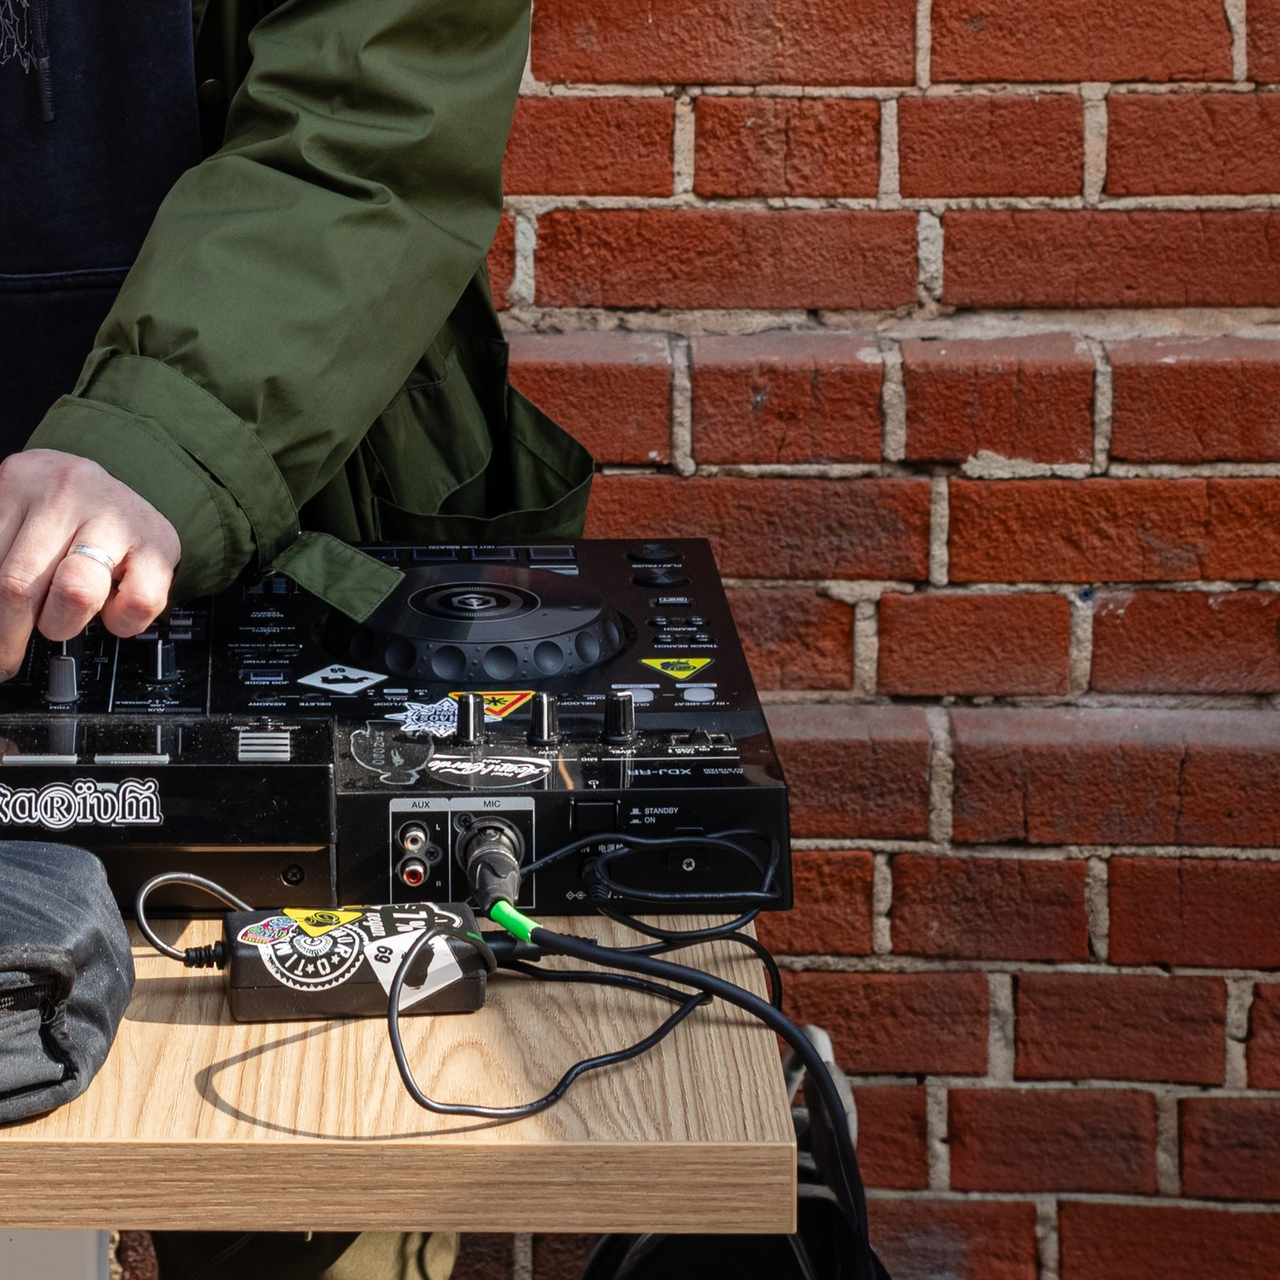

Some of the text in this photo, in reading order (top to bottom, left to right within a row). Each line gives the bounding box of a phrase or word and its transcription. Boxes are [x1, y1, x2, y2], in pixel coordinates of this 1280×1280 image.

[411, 800, 431, 809] AUX
[483, 800, 501, 808] MIC
[644, 806, 679, 815] STANDBY
[644, 816, 656, 824] ON
[374, 945, 394, 965] 69
